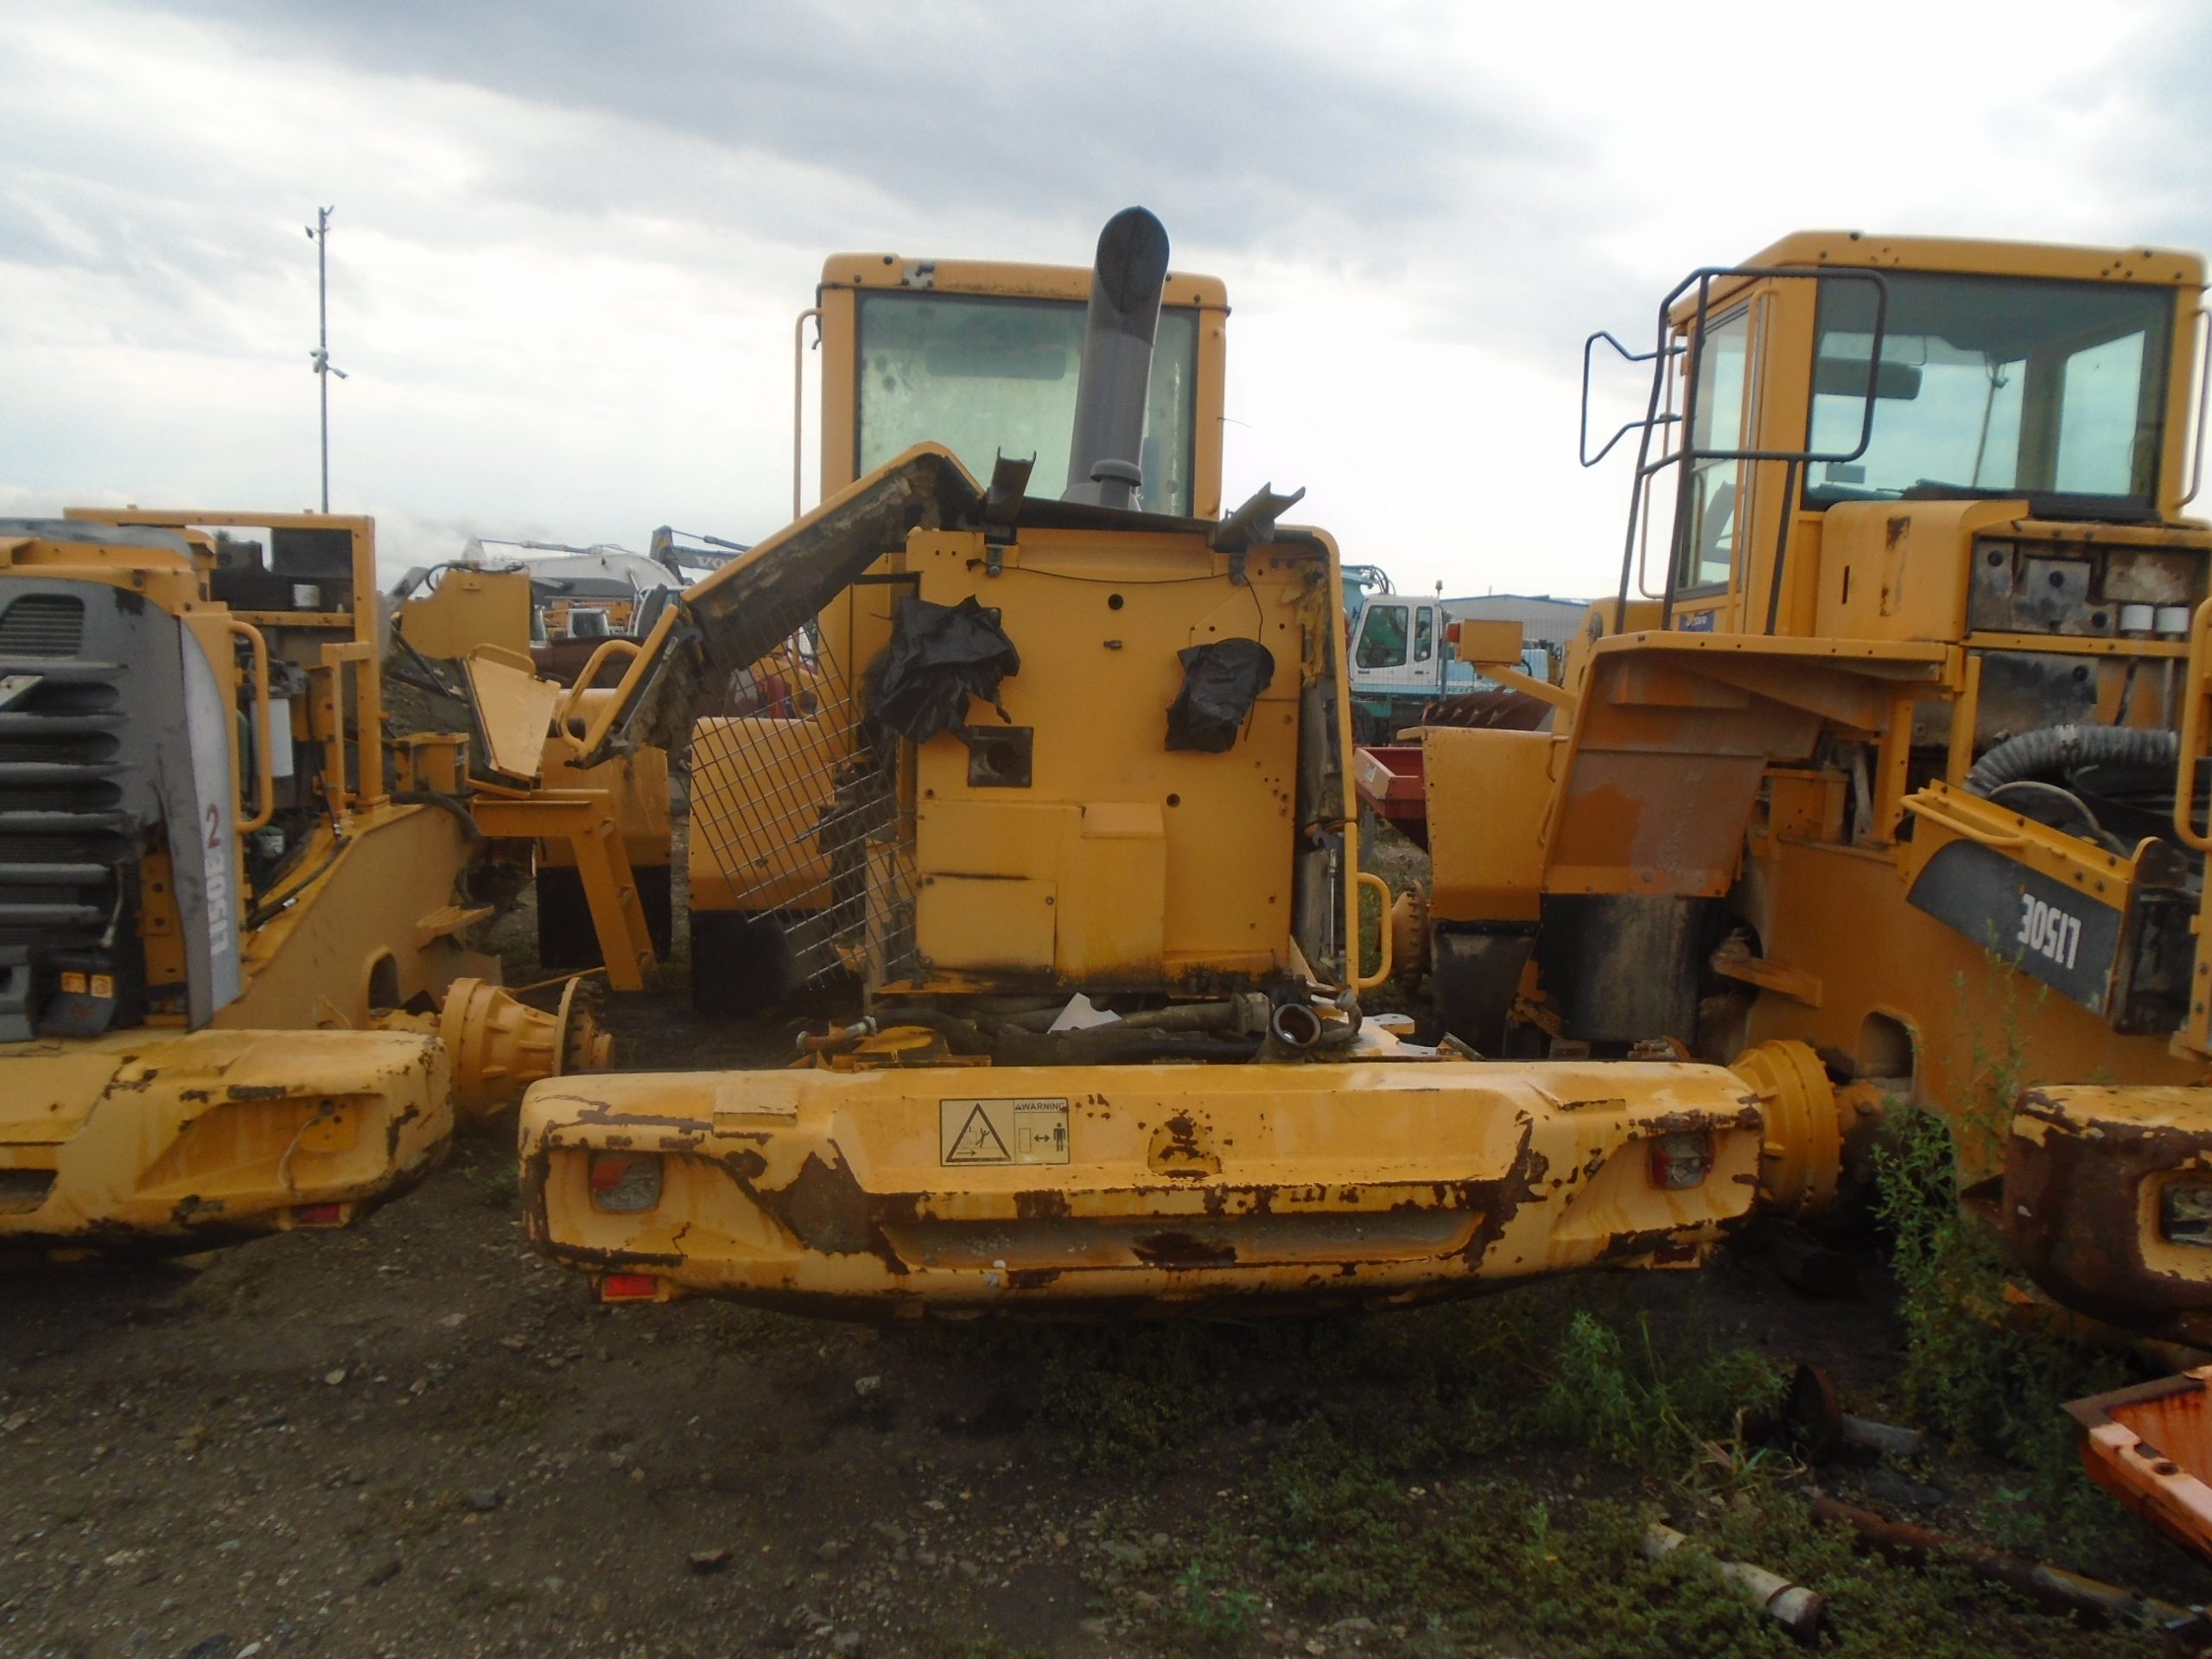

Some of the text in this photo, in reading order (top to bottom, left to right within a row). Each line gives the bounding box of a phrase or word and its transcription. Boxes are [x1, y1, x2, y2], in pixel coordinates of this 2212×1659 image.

[694, 556, 733, 568] VO
[207, 804, 221, 849] 2
[2018, 893, 2082, 969] L150E
[1021, 1103, 1066, 1111] WARNING
